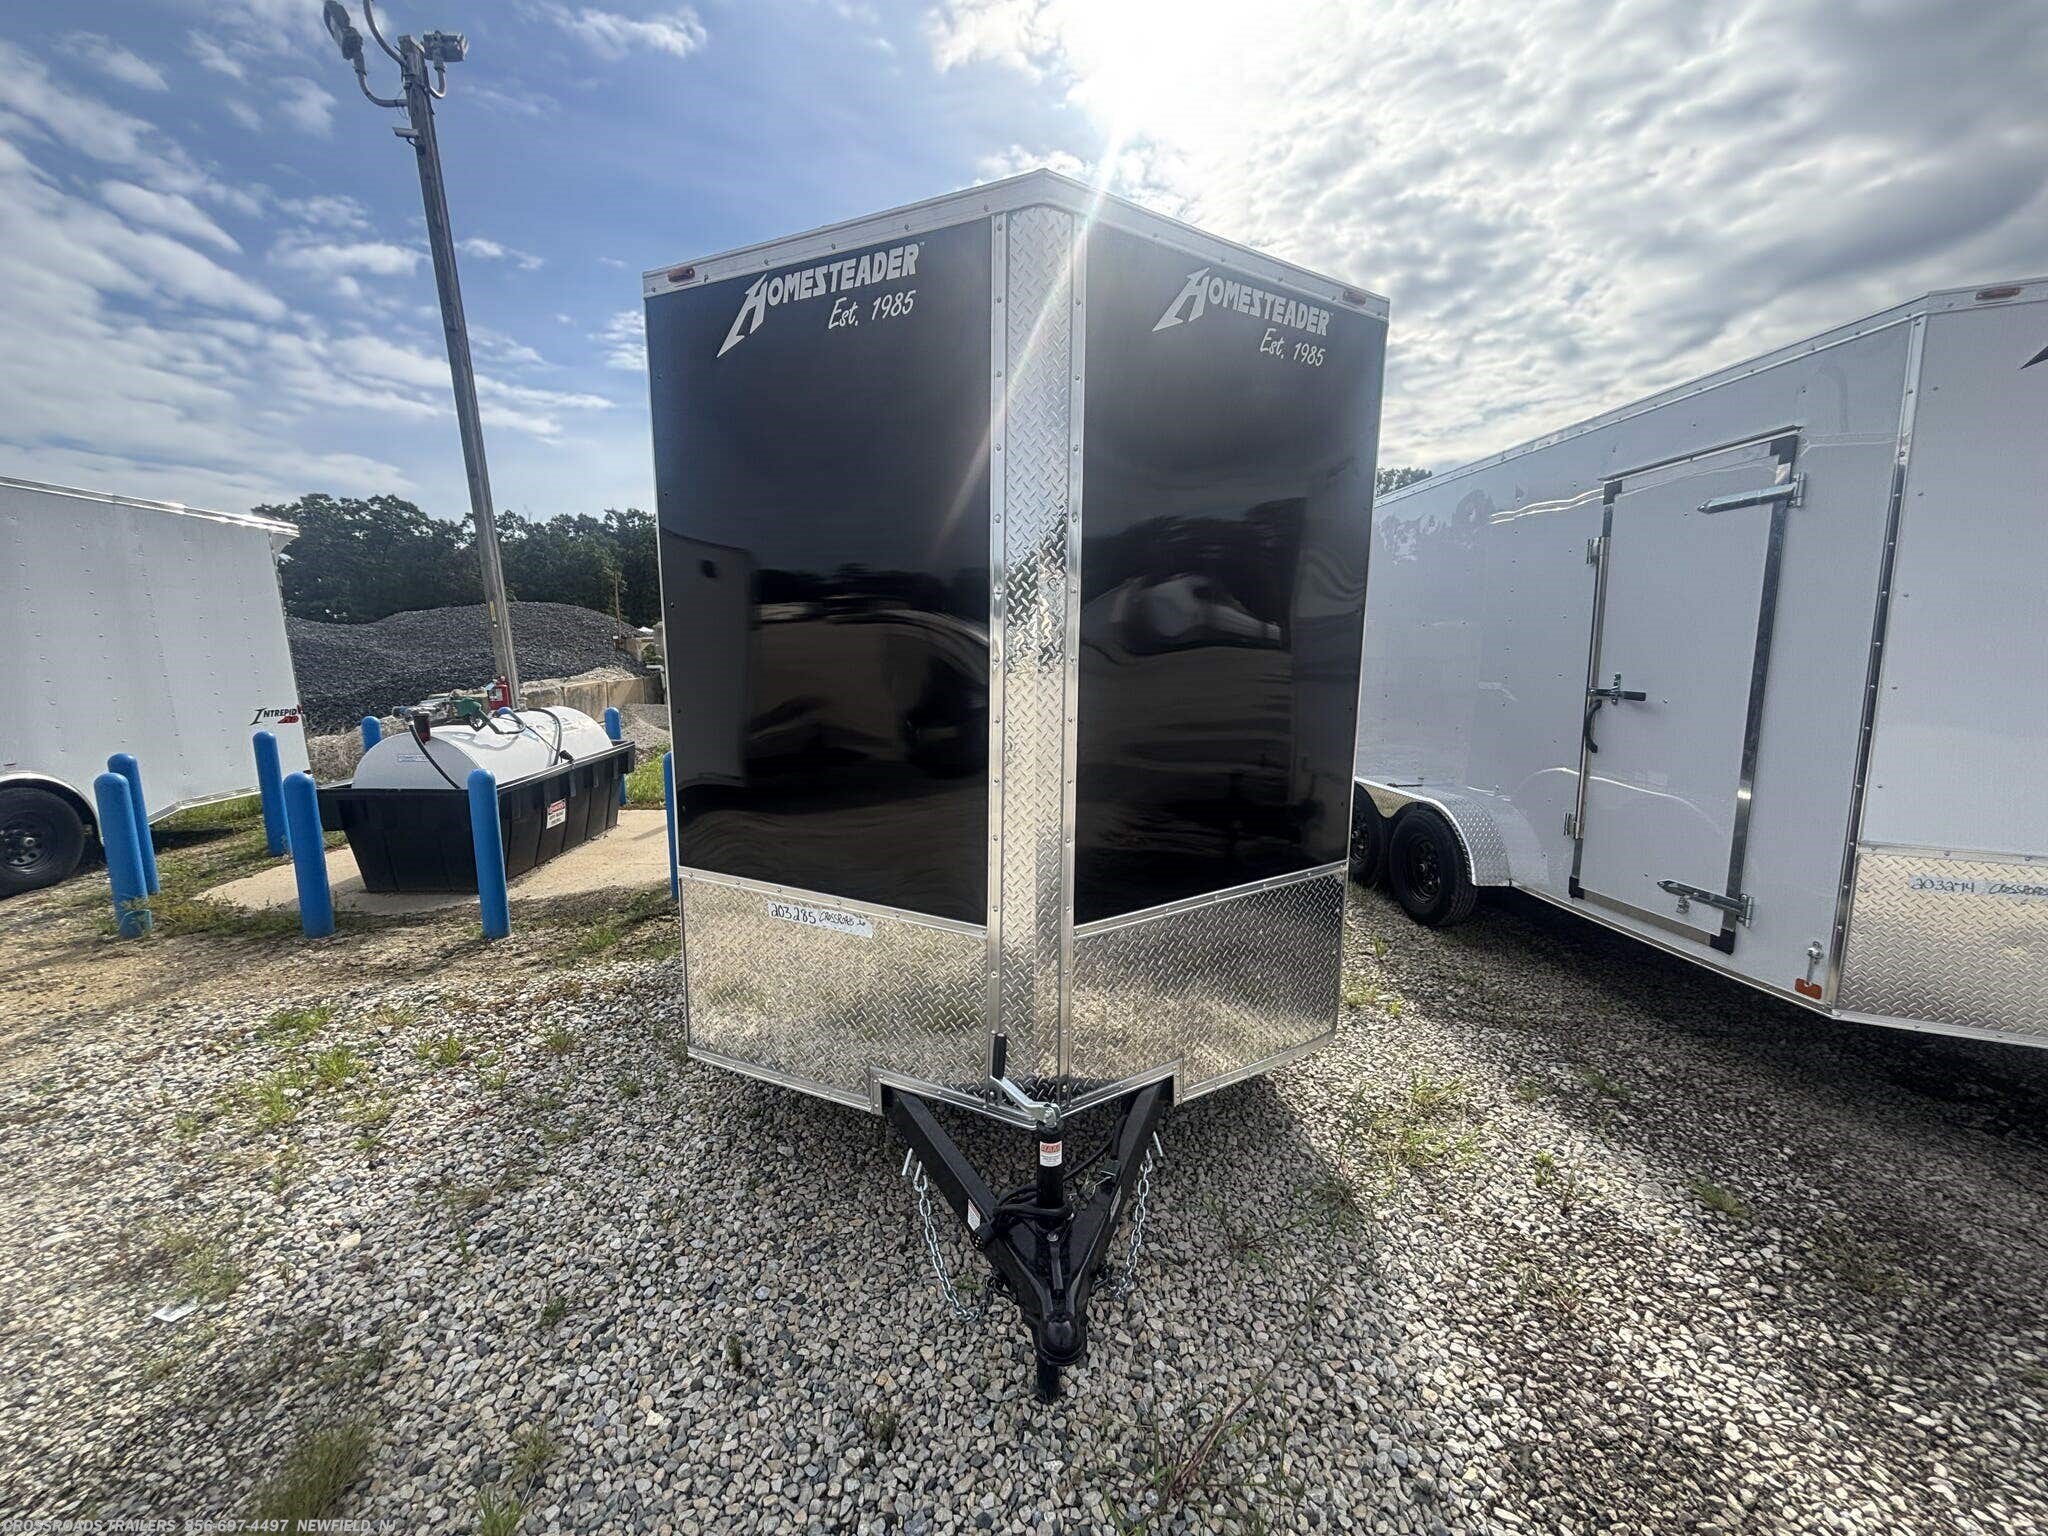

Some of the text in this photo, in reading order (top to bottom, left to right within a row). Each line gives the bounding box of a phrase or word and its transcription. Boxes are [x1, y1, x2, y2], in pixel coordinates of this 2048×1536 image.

[716, 243, 921, 358] HOMESTEADER
[828, 290, 917, 330] Est. 1985
[1152, 267, 1330, 336] HOMESTEADER
[1260, 328, 1326, 367] Est. 1985
[249, 707, 298, 726] INTREPID
[1911, 878, 1975, 894] 203274
[771, 902, 817, 925] 203285
